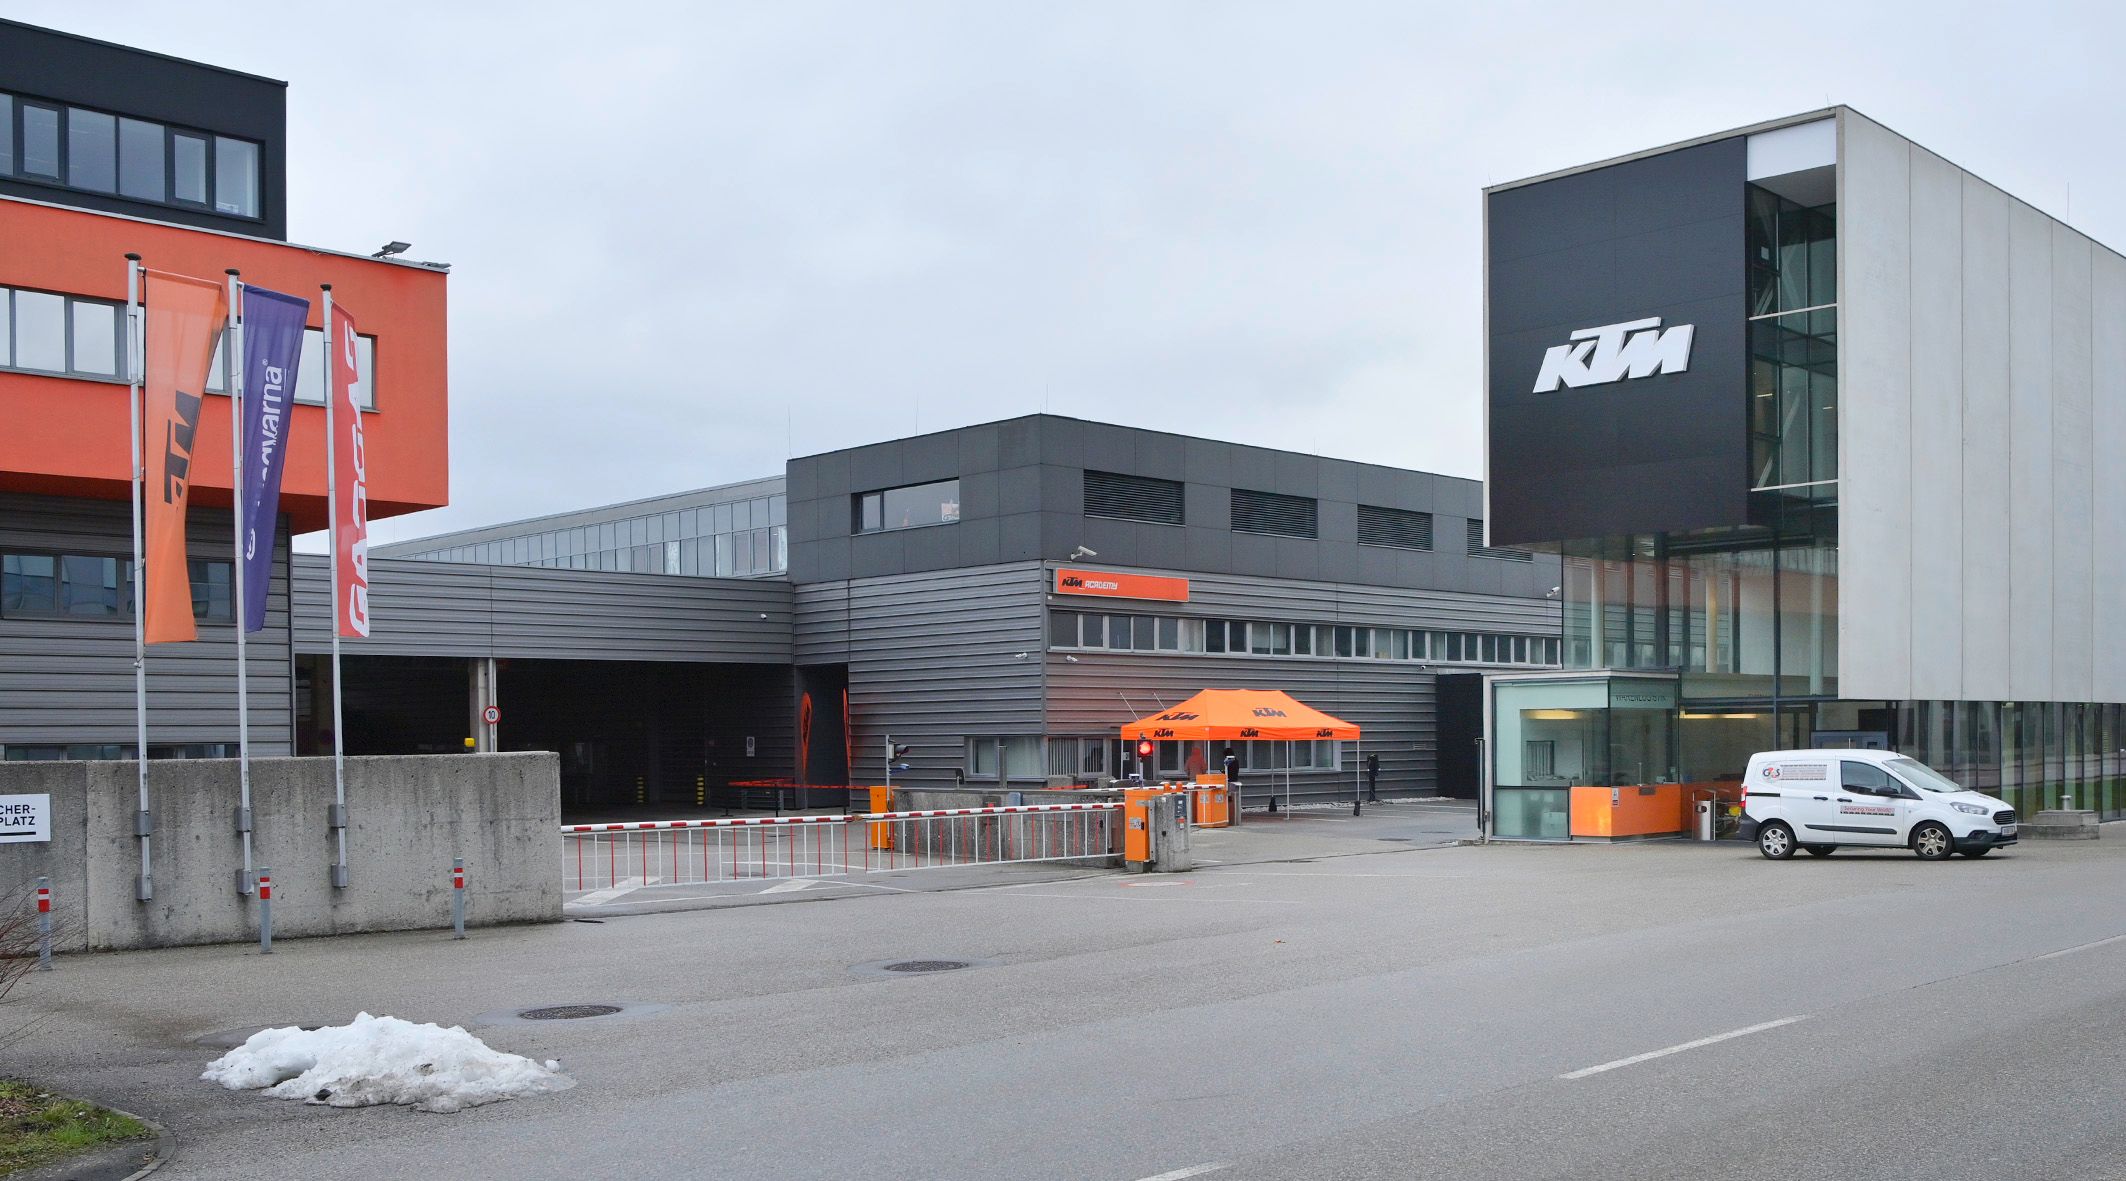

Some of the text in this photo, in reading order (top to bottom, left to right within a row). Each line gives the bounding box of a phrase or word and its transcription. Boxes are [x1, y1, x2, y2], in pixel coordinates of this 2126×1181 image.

[1532, 316, 1695, 393] KTM
[163, 389, 201, 513] TM
[488, 710, 496, 719] 10
[1252, 708, 1287, 718] KTM
[1154, 728, 1174, 737] KTM
[1240, 728, 1259, 737] KTM
[1317, 728, 1333, 737] KTM
